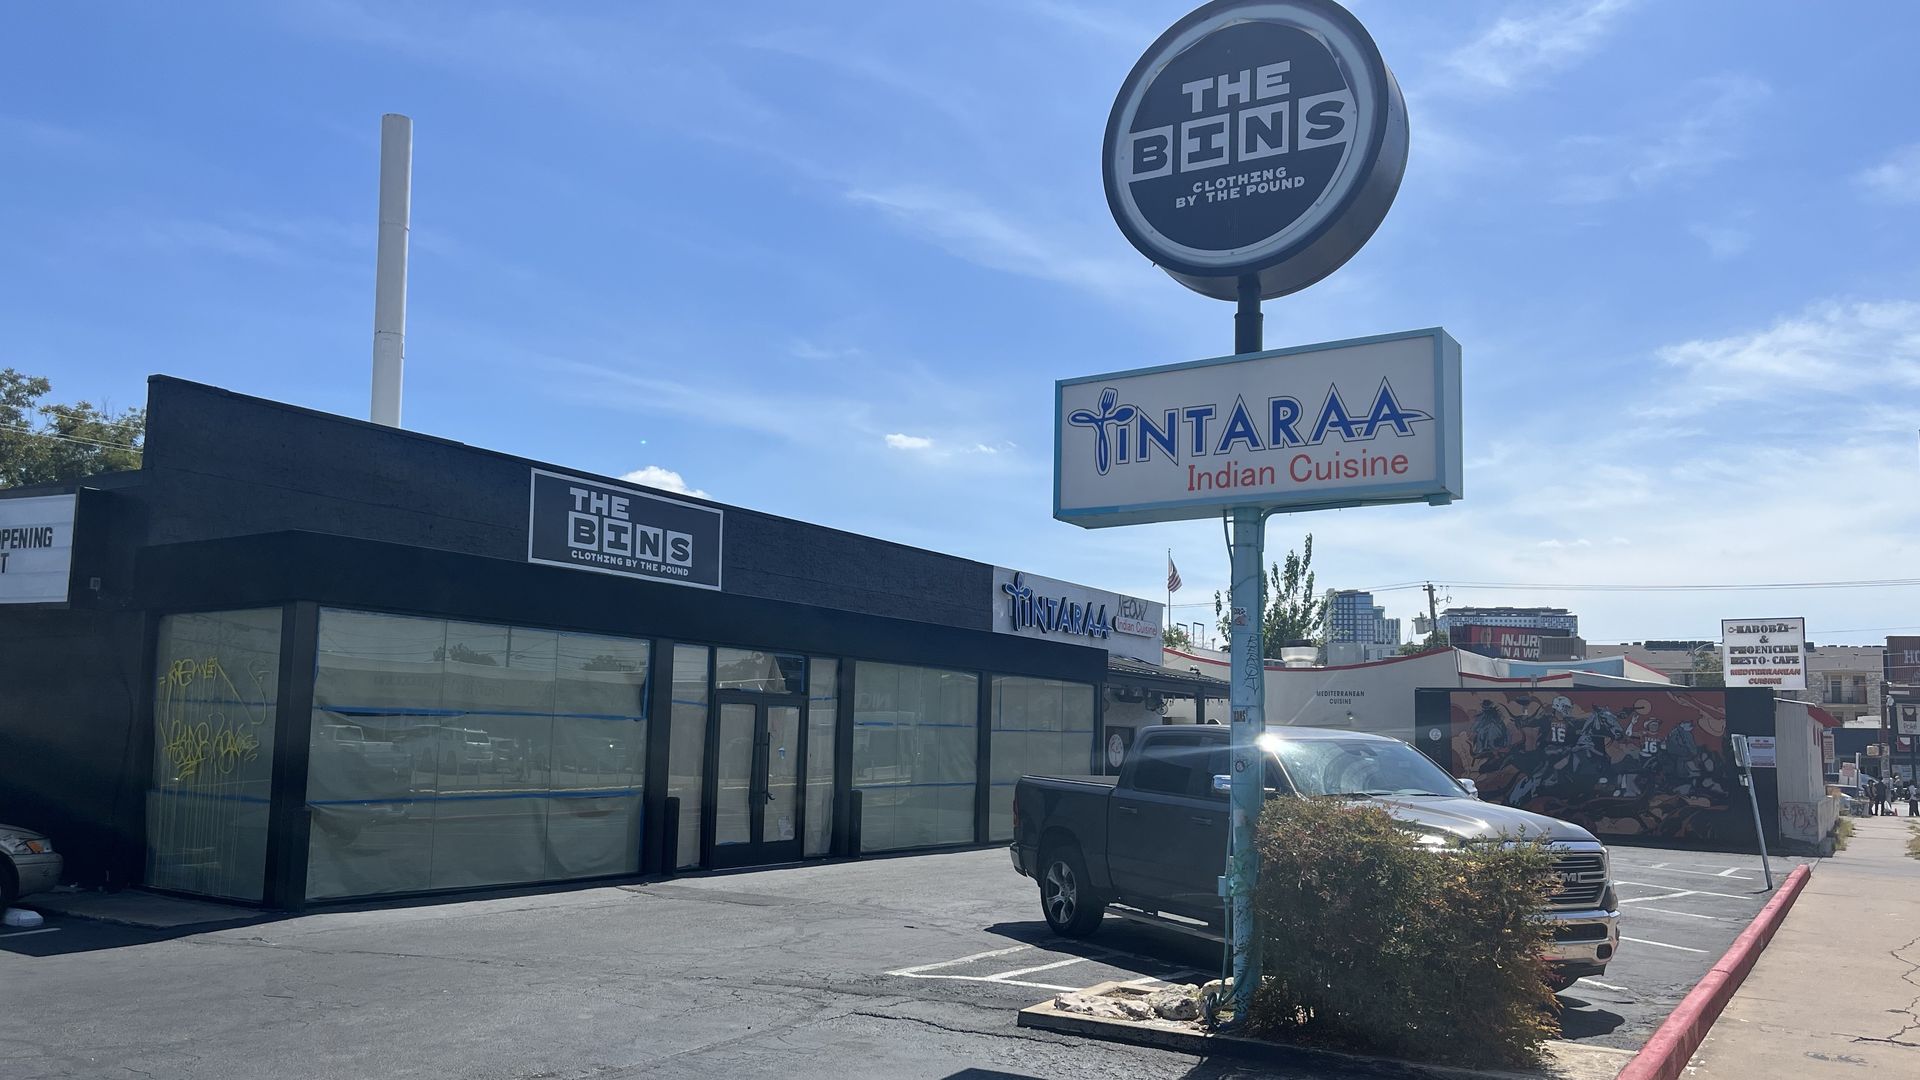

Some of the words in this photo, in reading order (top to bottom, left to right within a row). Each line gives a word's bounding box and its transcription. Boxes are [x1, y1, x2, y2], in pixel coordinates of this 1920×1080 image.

[1182, 60, 1291, 114] THE
[1131, 98, 1347, 177] BINS
[1175, 194, 1198, 209] BY
[1206, 186, 1240, 203] THE
[1246, 176, 1305, 196] POUND
[1193, 166, 1287, 193] CLOTHING
[1187, 461, 1275, 491] Indian
[1290, 448, 1409, 482] Cuisine
[569, 486, 630, 520] THE
[0, 526, 53, 549] PENING
[570, 514, 691, 565] BINS
[571, 549, 623, 566] CLOTHING
[625, 559, 637, 568] BY
[640, 561, 658, 572] THE
[660, 564, 689, 577] POUND
[1501, 633, 1539, 647] INJUR
[1513, 647, 1520, 658] A
[1523, 647, 1539, 658] WR
[1759, 635, 1769, 643] &
[1730, 668, 1800, 676] MEDITERRANEAN
[1643, 741, 1657, 754] 16
